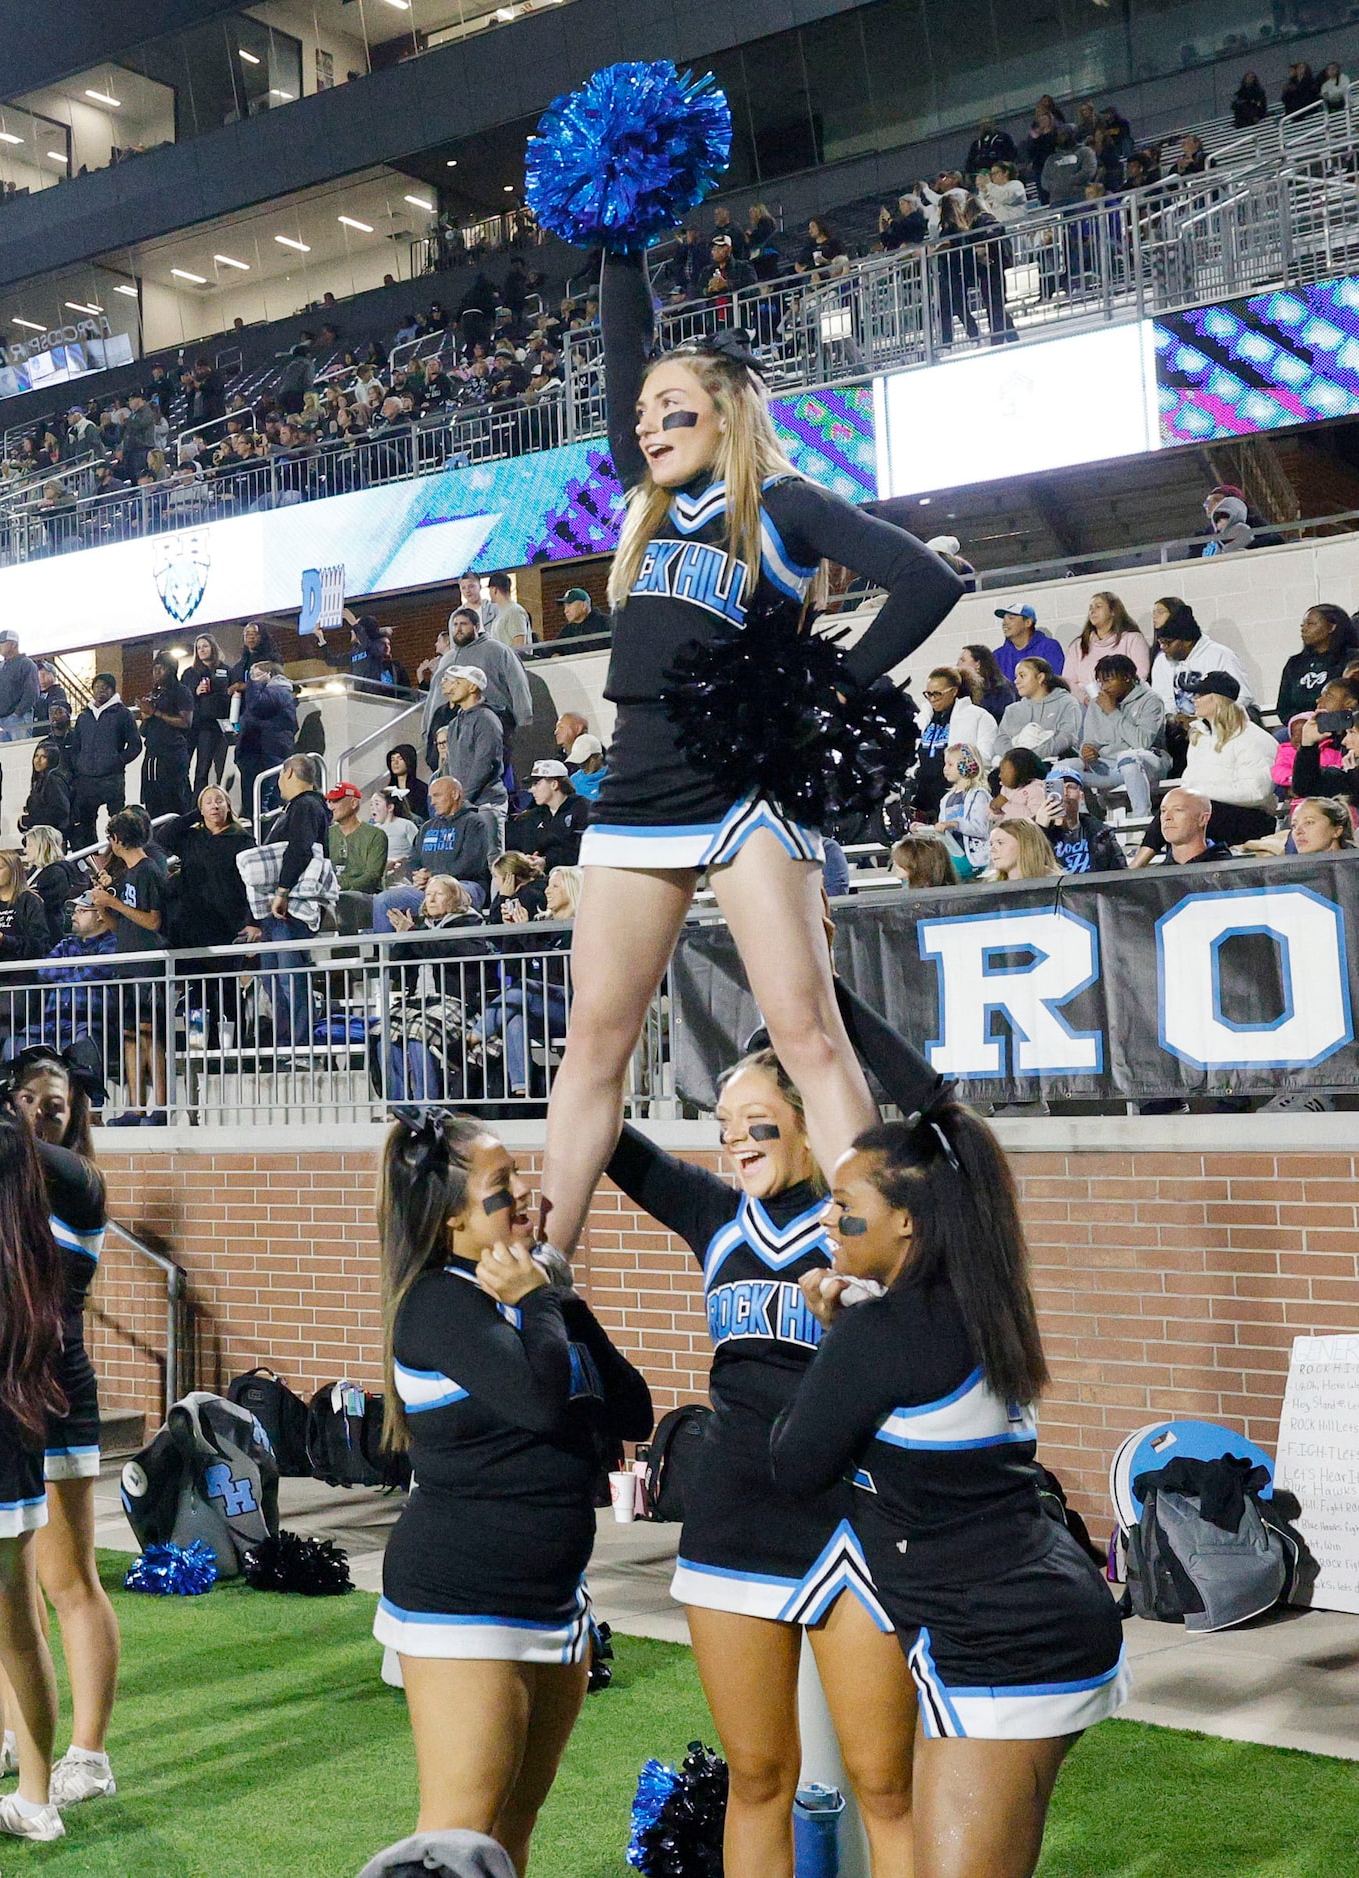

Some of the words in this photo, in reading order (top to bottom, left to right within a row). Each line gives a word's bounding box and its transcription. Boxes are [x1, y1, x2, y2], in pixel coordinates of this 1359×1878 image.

[672, 541, 749, 630] HILL
[706, 1280, 781, 1352] ROCK
[205, 1463, 258, 1517] RH
